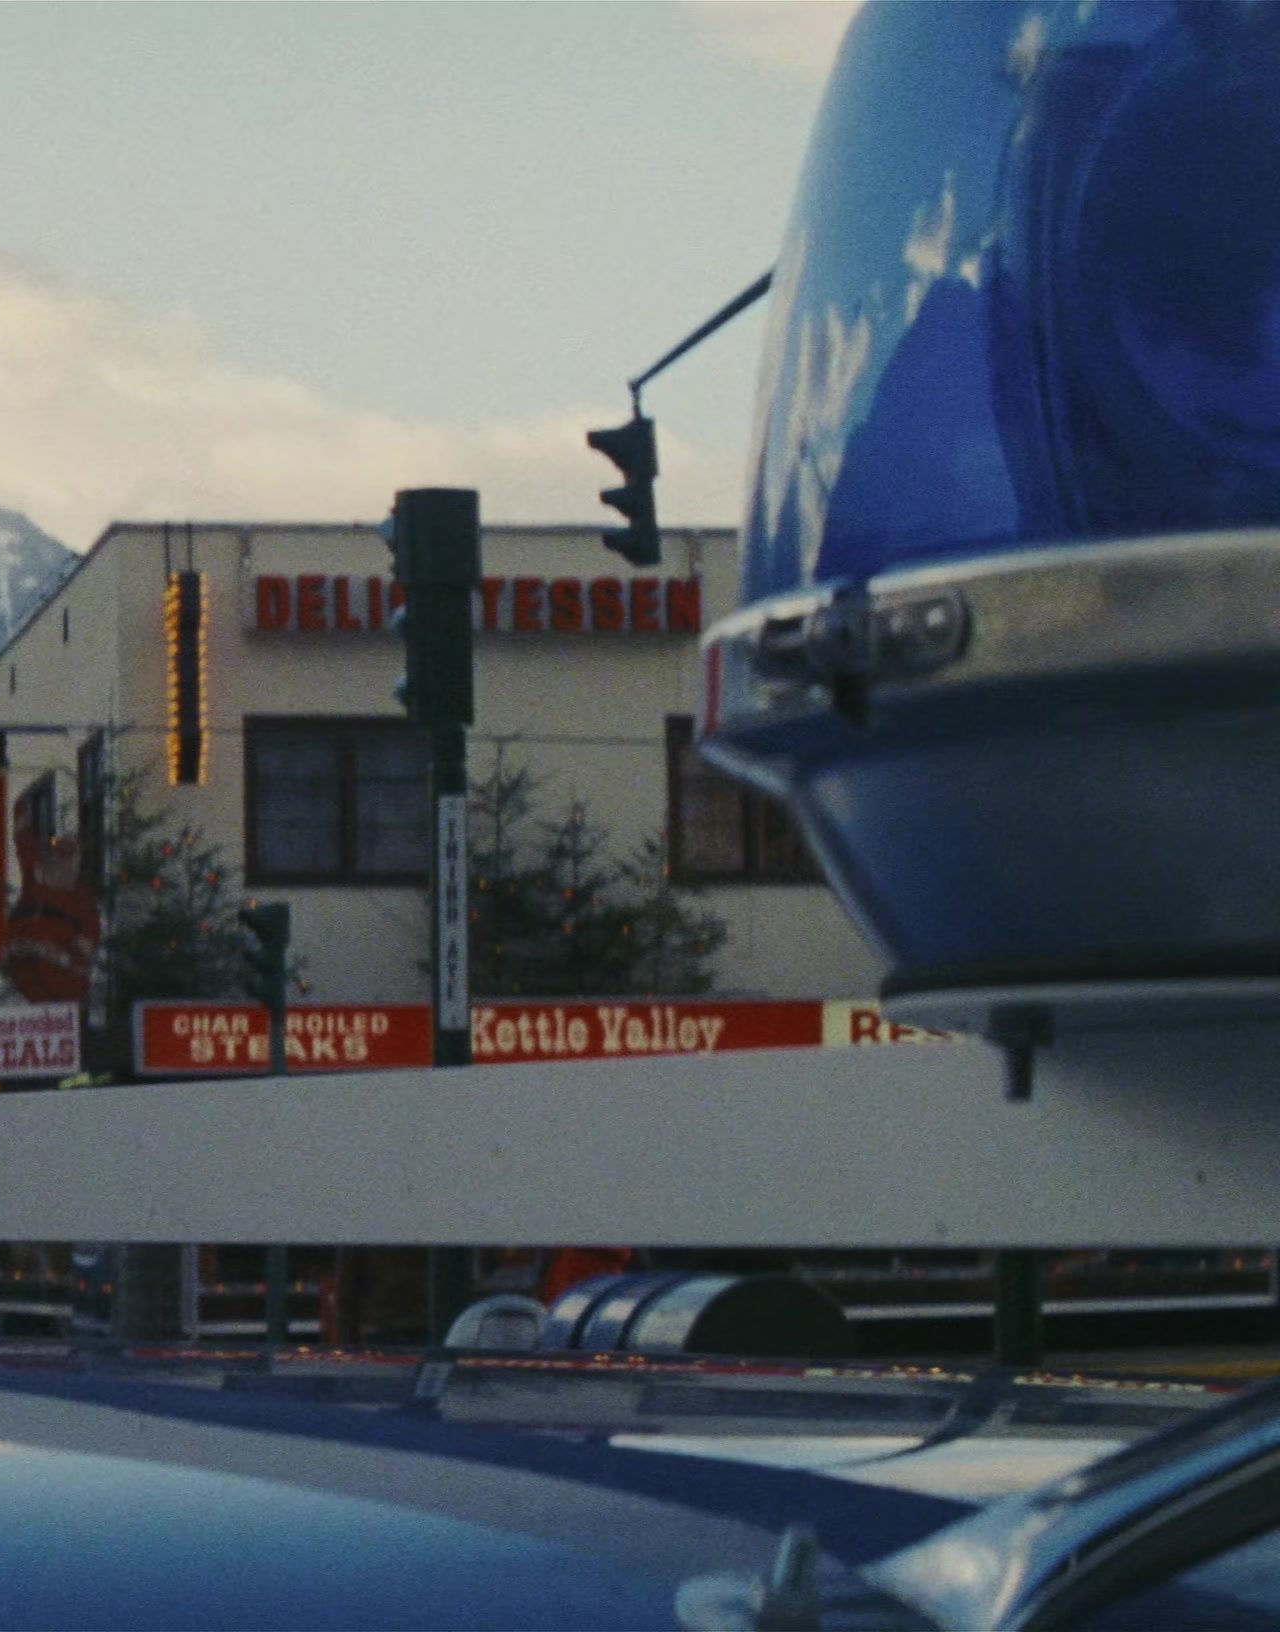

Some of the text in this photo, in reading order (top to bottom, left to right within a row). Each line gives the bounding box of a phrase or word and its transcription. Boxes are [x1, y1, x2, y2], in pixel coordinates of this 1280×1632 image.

[255, 575, 702, 633] DELITESSEN
[172, 1012, 389, 1036] CHAR ROILED
[470, 1006, 724, 1056] Kettle Valley
[190, 1034, 369, 1063] STEAKS
